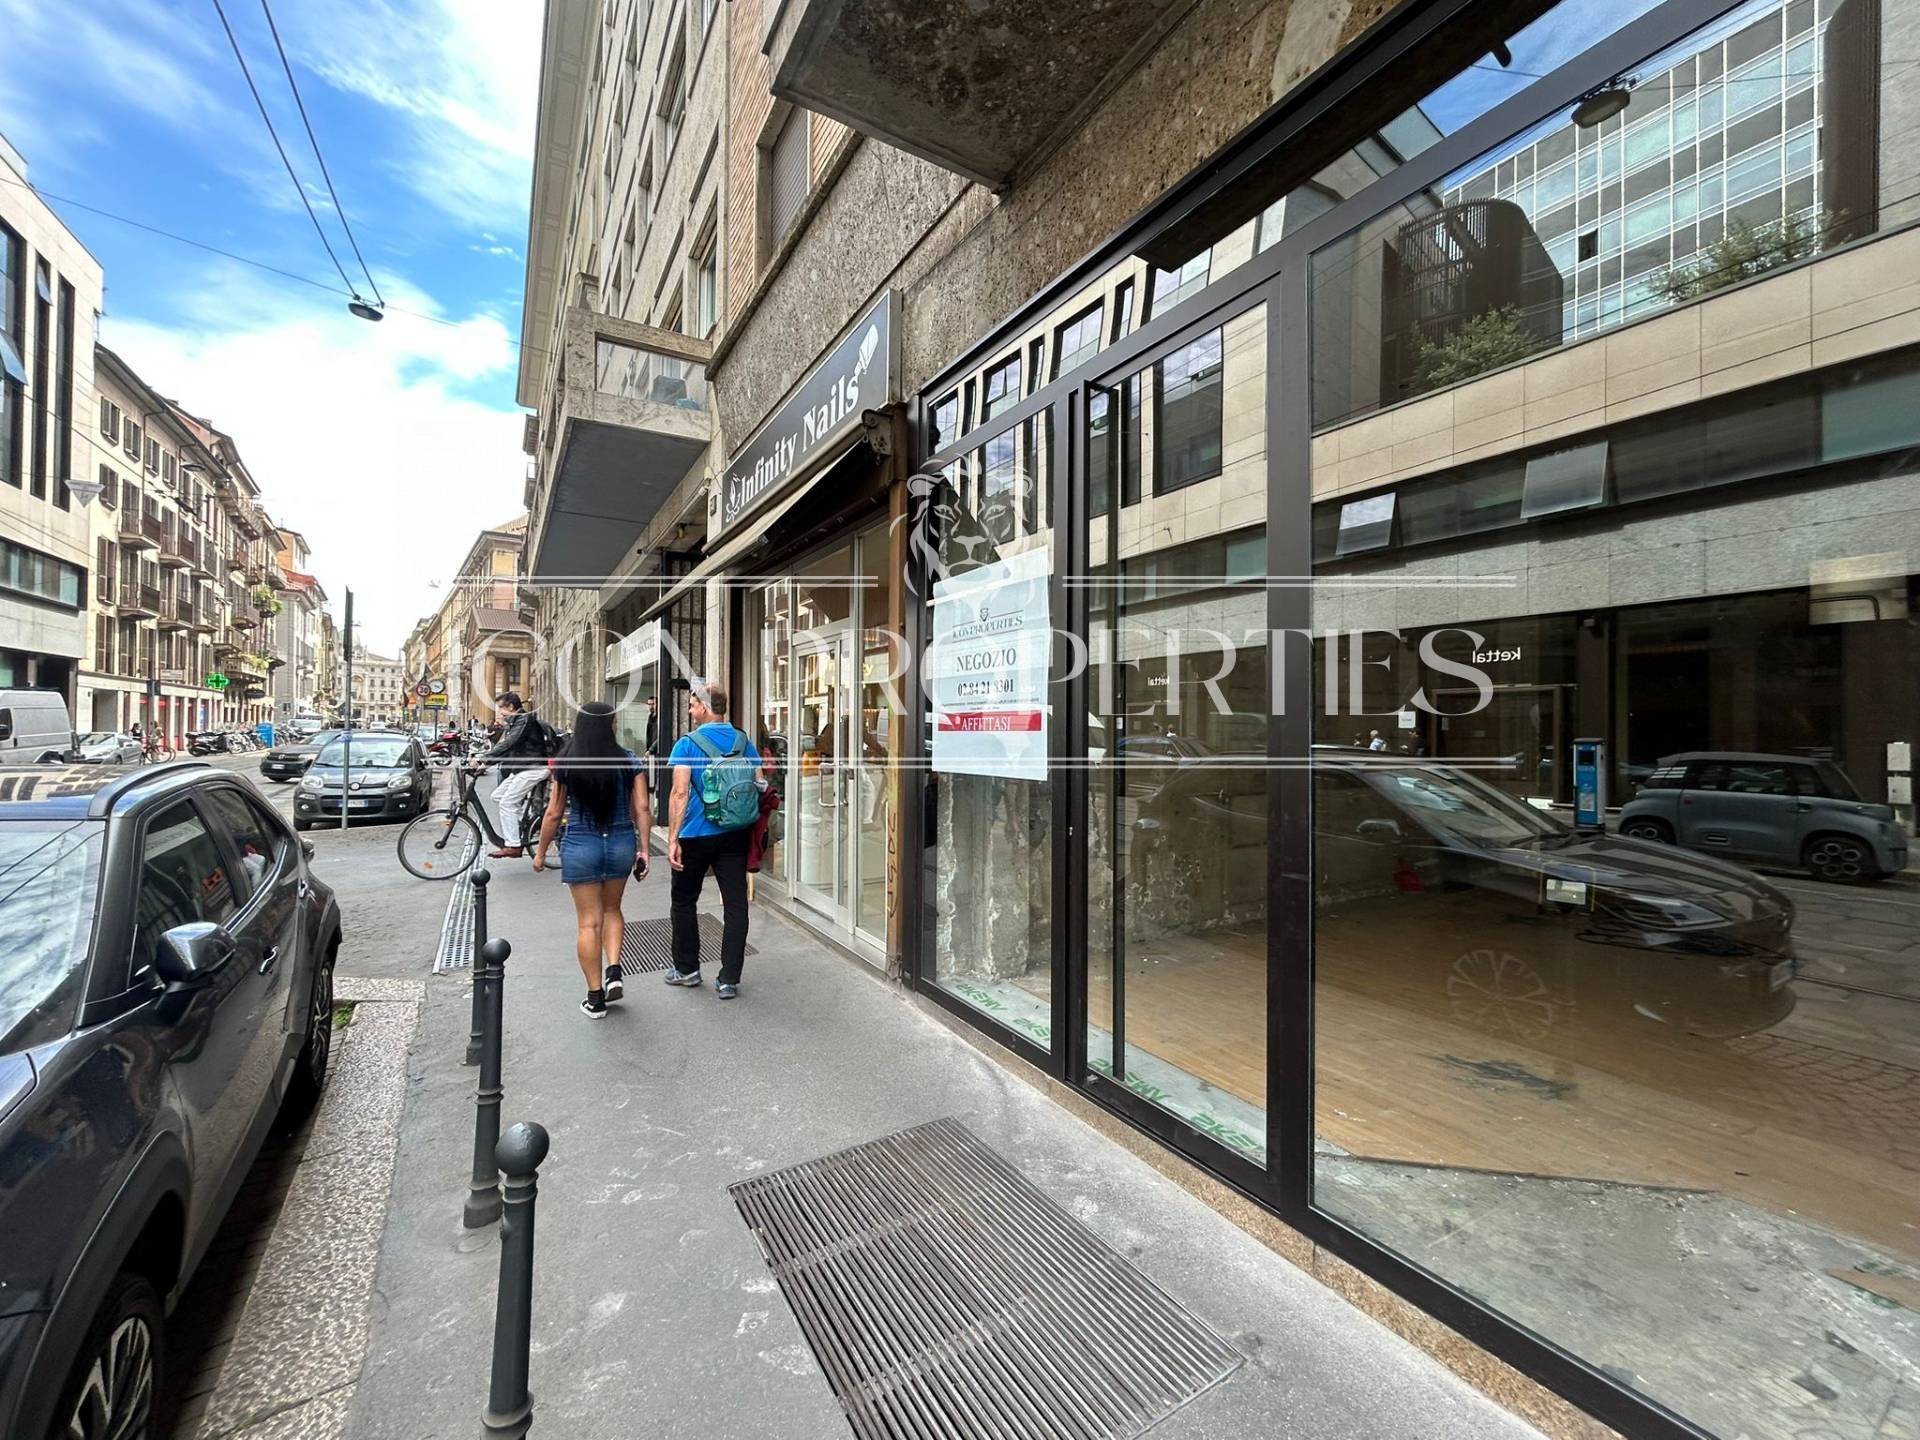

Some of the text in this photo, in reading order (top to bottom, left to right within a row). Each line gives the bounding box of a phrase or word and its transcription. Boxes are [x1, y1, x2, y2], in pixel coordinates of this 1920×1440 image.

[739, 374, 860, 507] Infinity Nails
[956, 647, 1017, 673] NEGOZIO
[961, 716, 1011, 731] AFFITTASI
